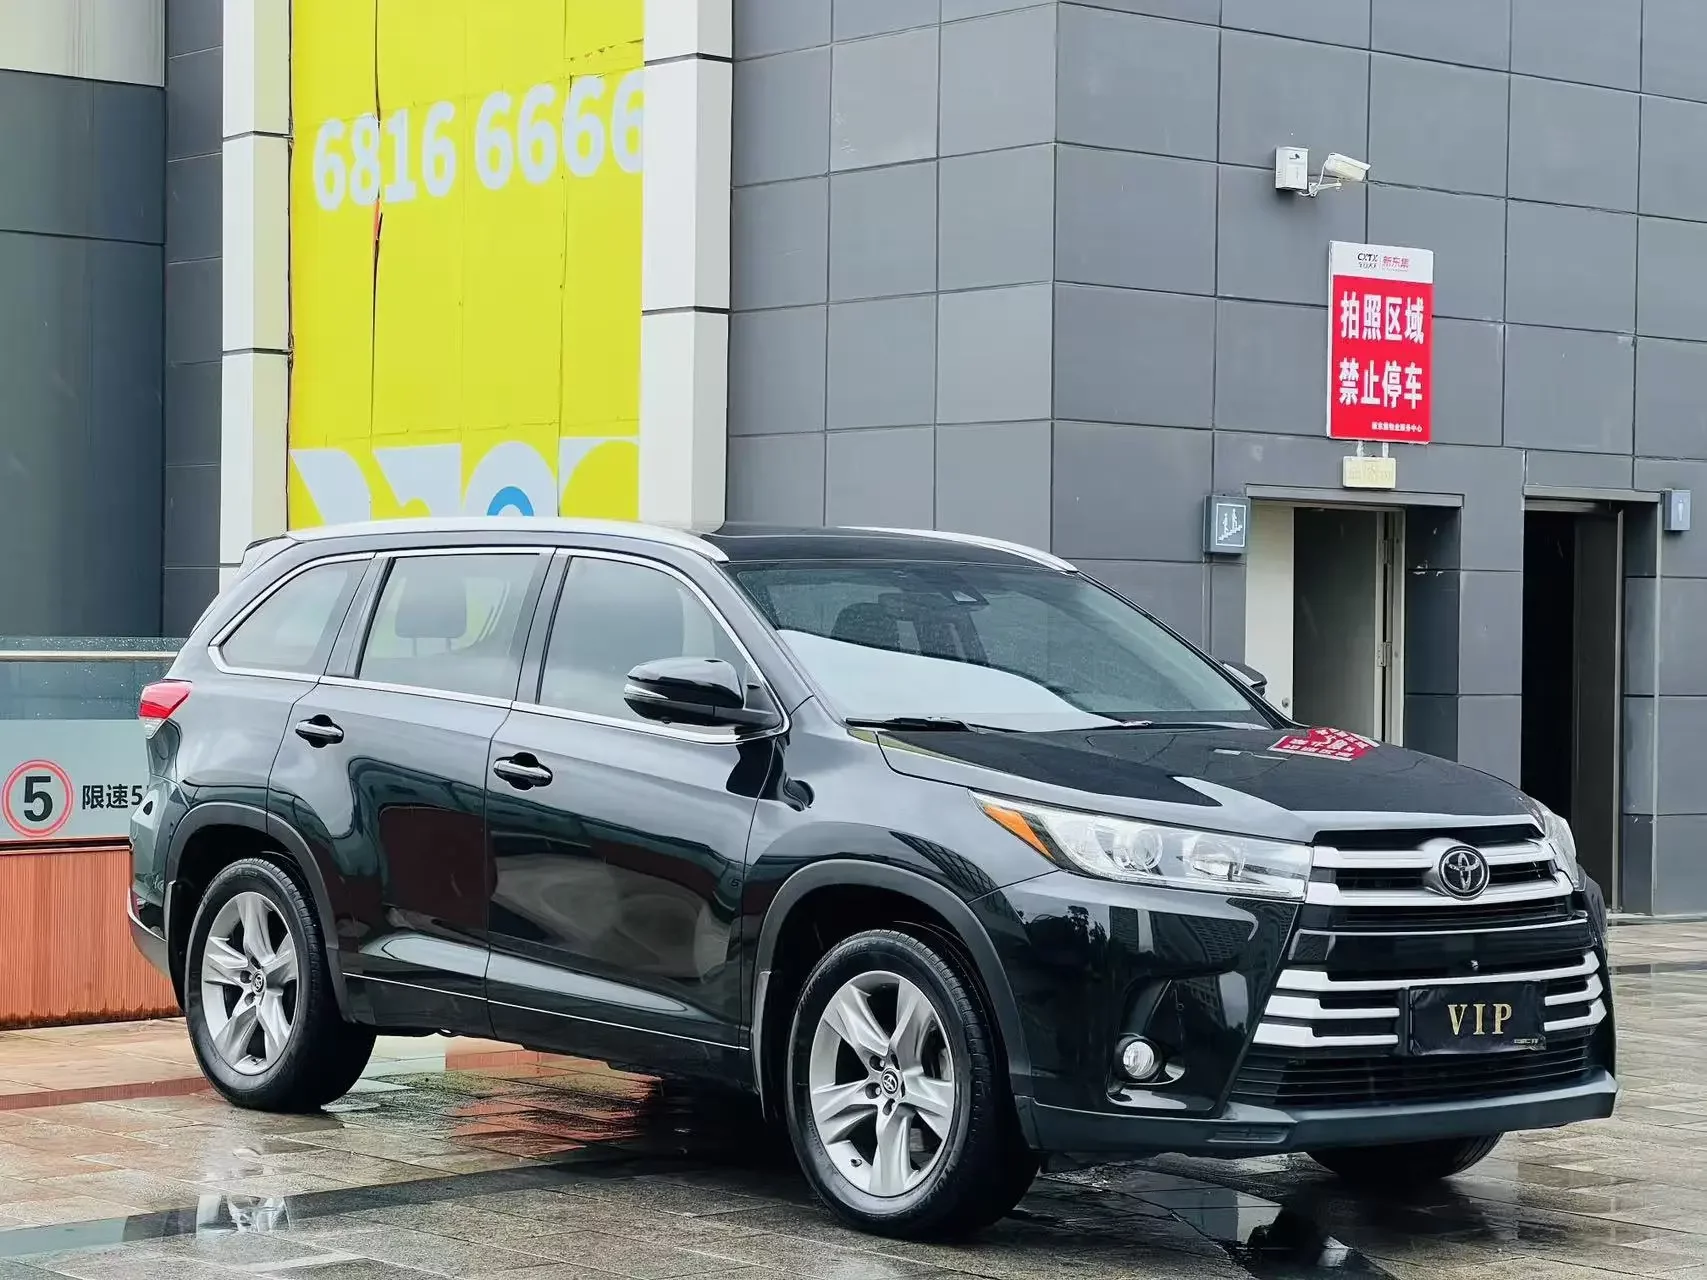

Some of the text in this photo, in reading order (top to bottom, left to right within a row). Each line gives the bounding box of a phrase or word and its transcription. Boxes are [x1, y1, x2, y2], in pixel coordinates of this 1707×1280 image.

[313, 70, 645, 212] 6816 6666
[1340, 290, 1425, 345] 拍照区域
[1338, 356, 1424, 410] 禁止停车
[23, 775, 54, 822] 5
[82, 783, 150, 810] 限速5
[1447, 1003, 1513, 1036] VIP
